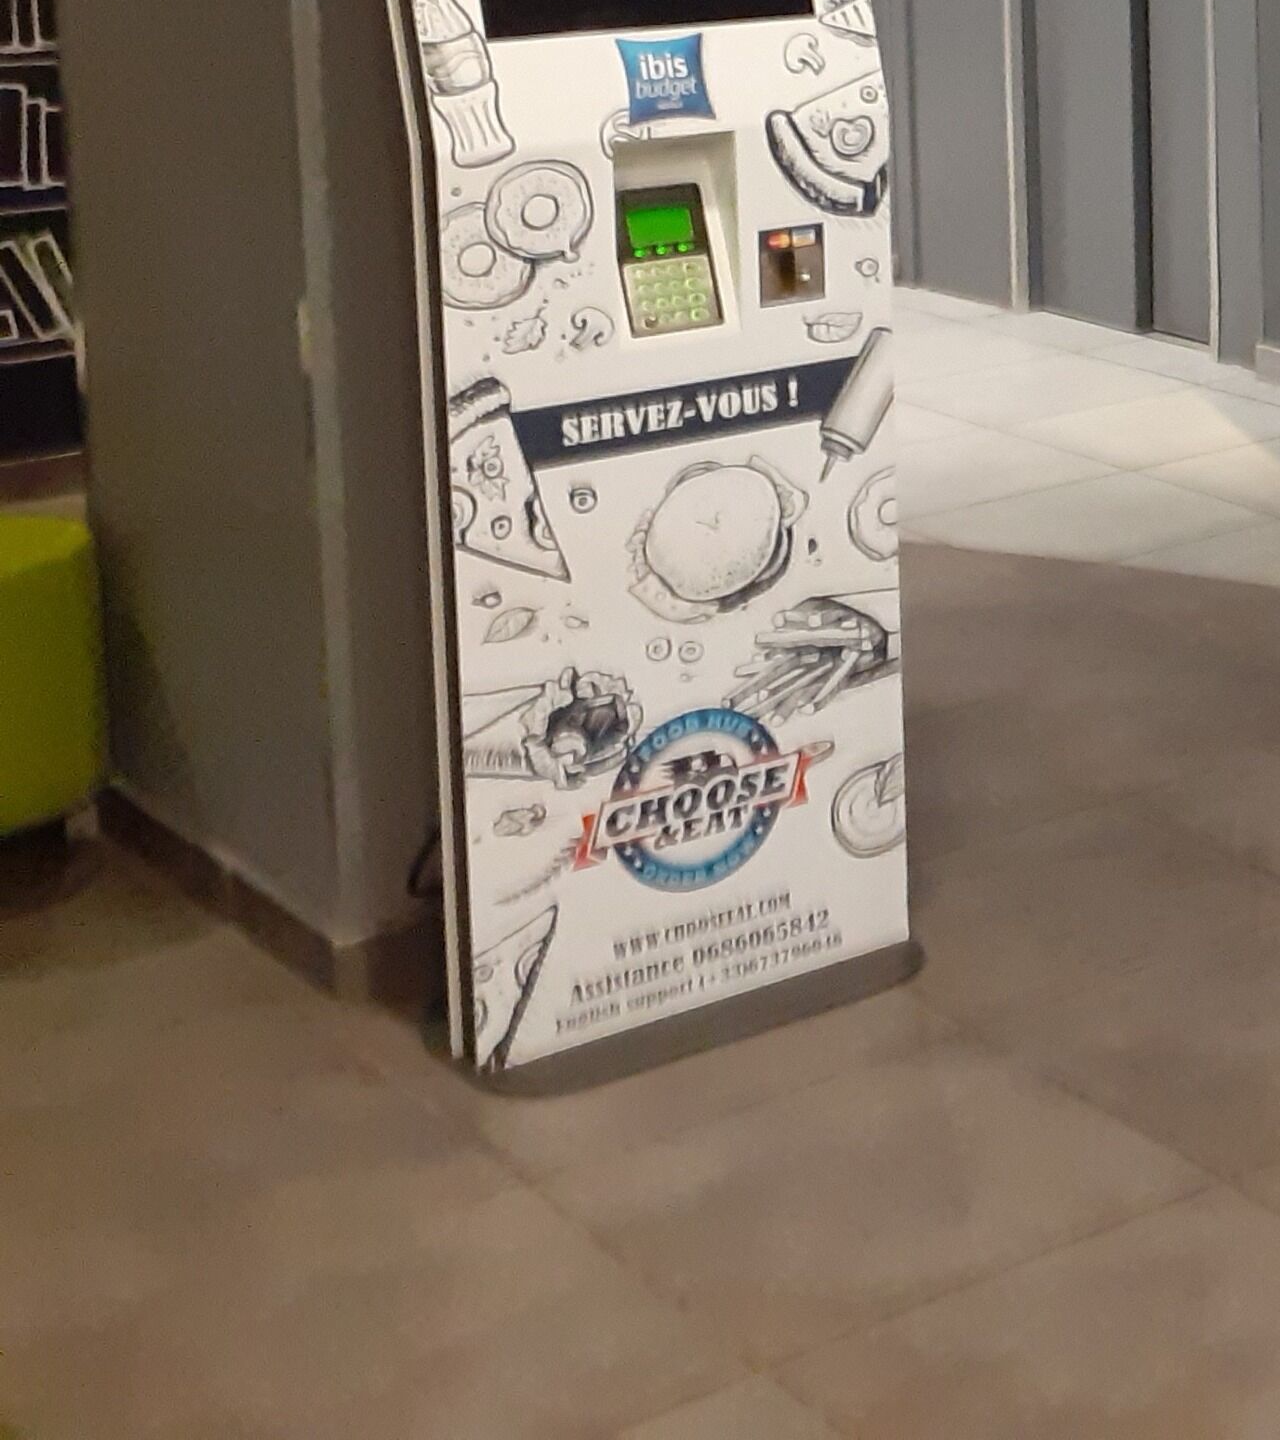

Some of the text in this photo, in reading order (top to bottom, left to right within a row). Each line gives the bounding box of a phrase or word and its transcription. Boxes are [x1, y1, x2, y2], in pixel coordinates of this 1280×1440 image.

[635, 75, 698, 101] budget
[639, 52, 689, 81] ibis
[561, 382, 778, 447] SERVEZ-VOUS
[605, 762, 790, 838] CHOOSE
[570, 956, 684, 1006] Assistance
